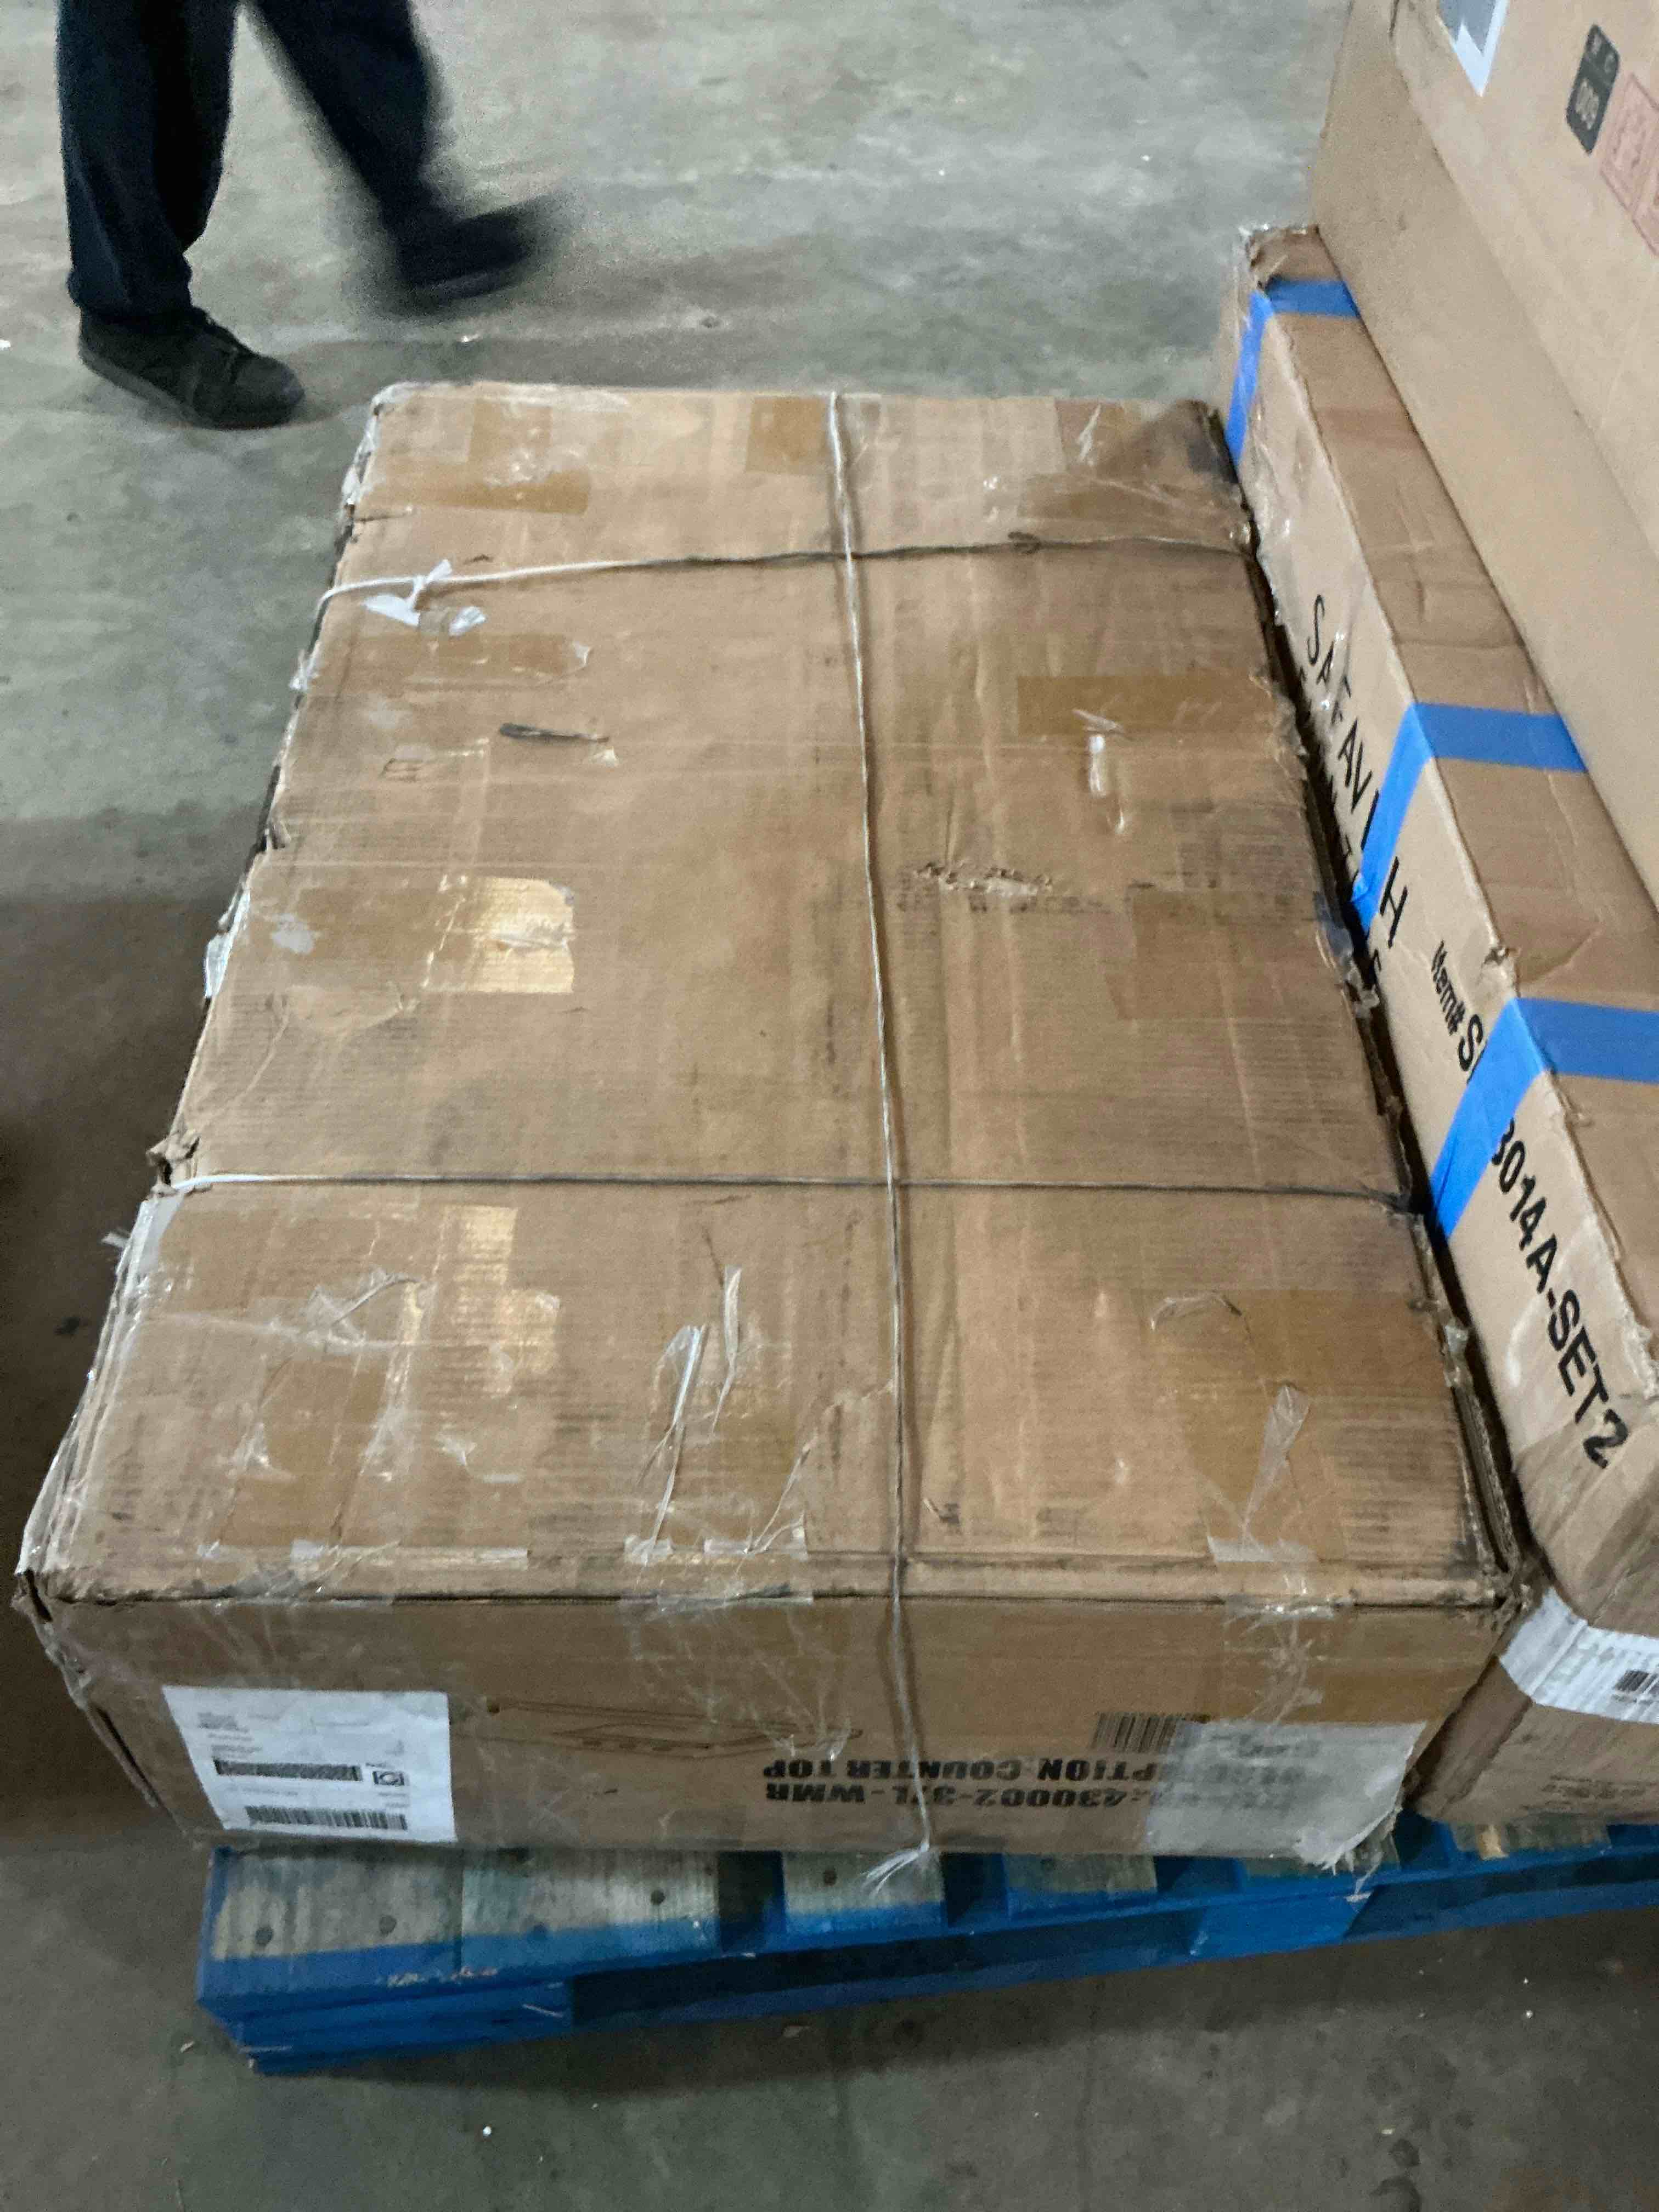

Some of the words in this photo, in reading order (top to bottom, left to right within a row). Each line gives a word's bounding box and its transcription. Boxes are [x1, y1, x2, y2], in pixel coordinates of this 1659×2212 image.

[1307, 595, 1408, 949] SAFAVIH
[1431, 939, 1465, 1036] Item#
[763, 1758, 834, 1778] TOP
[847, 1759, 1022, 1781] COUNTER
